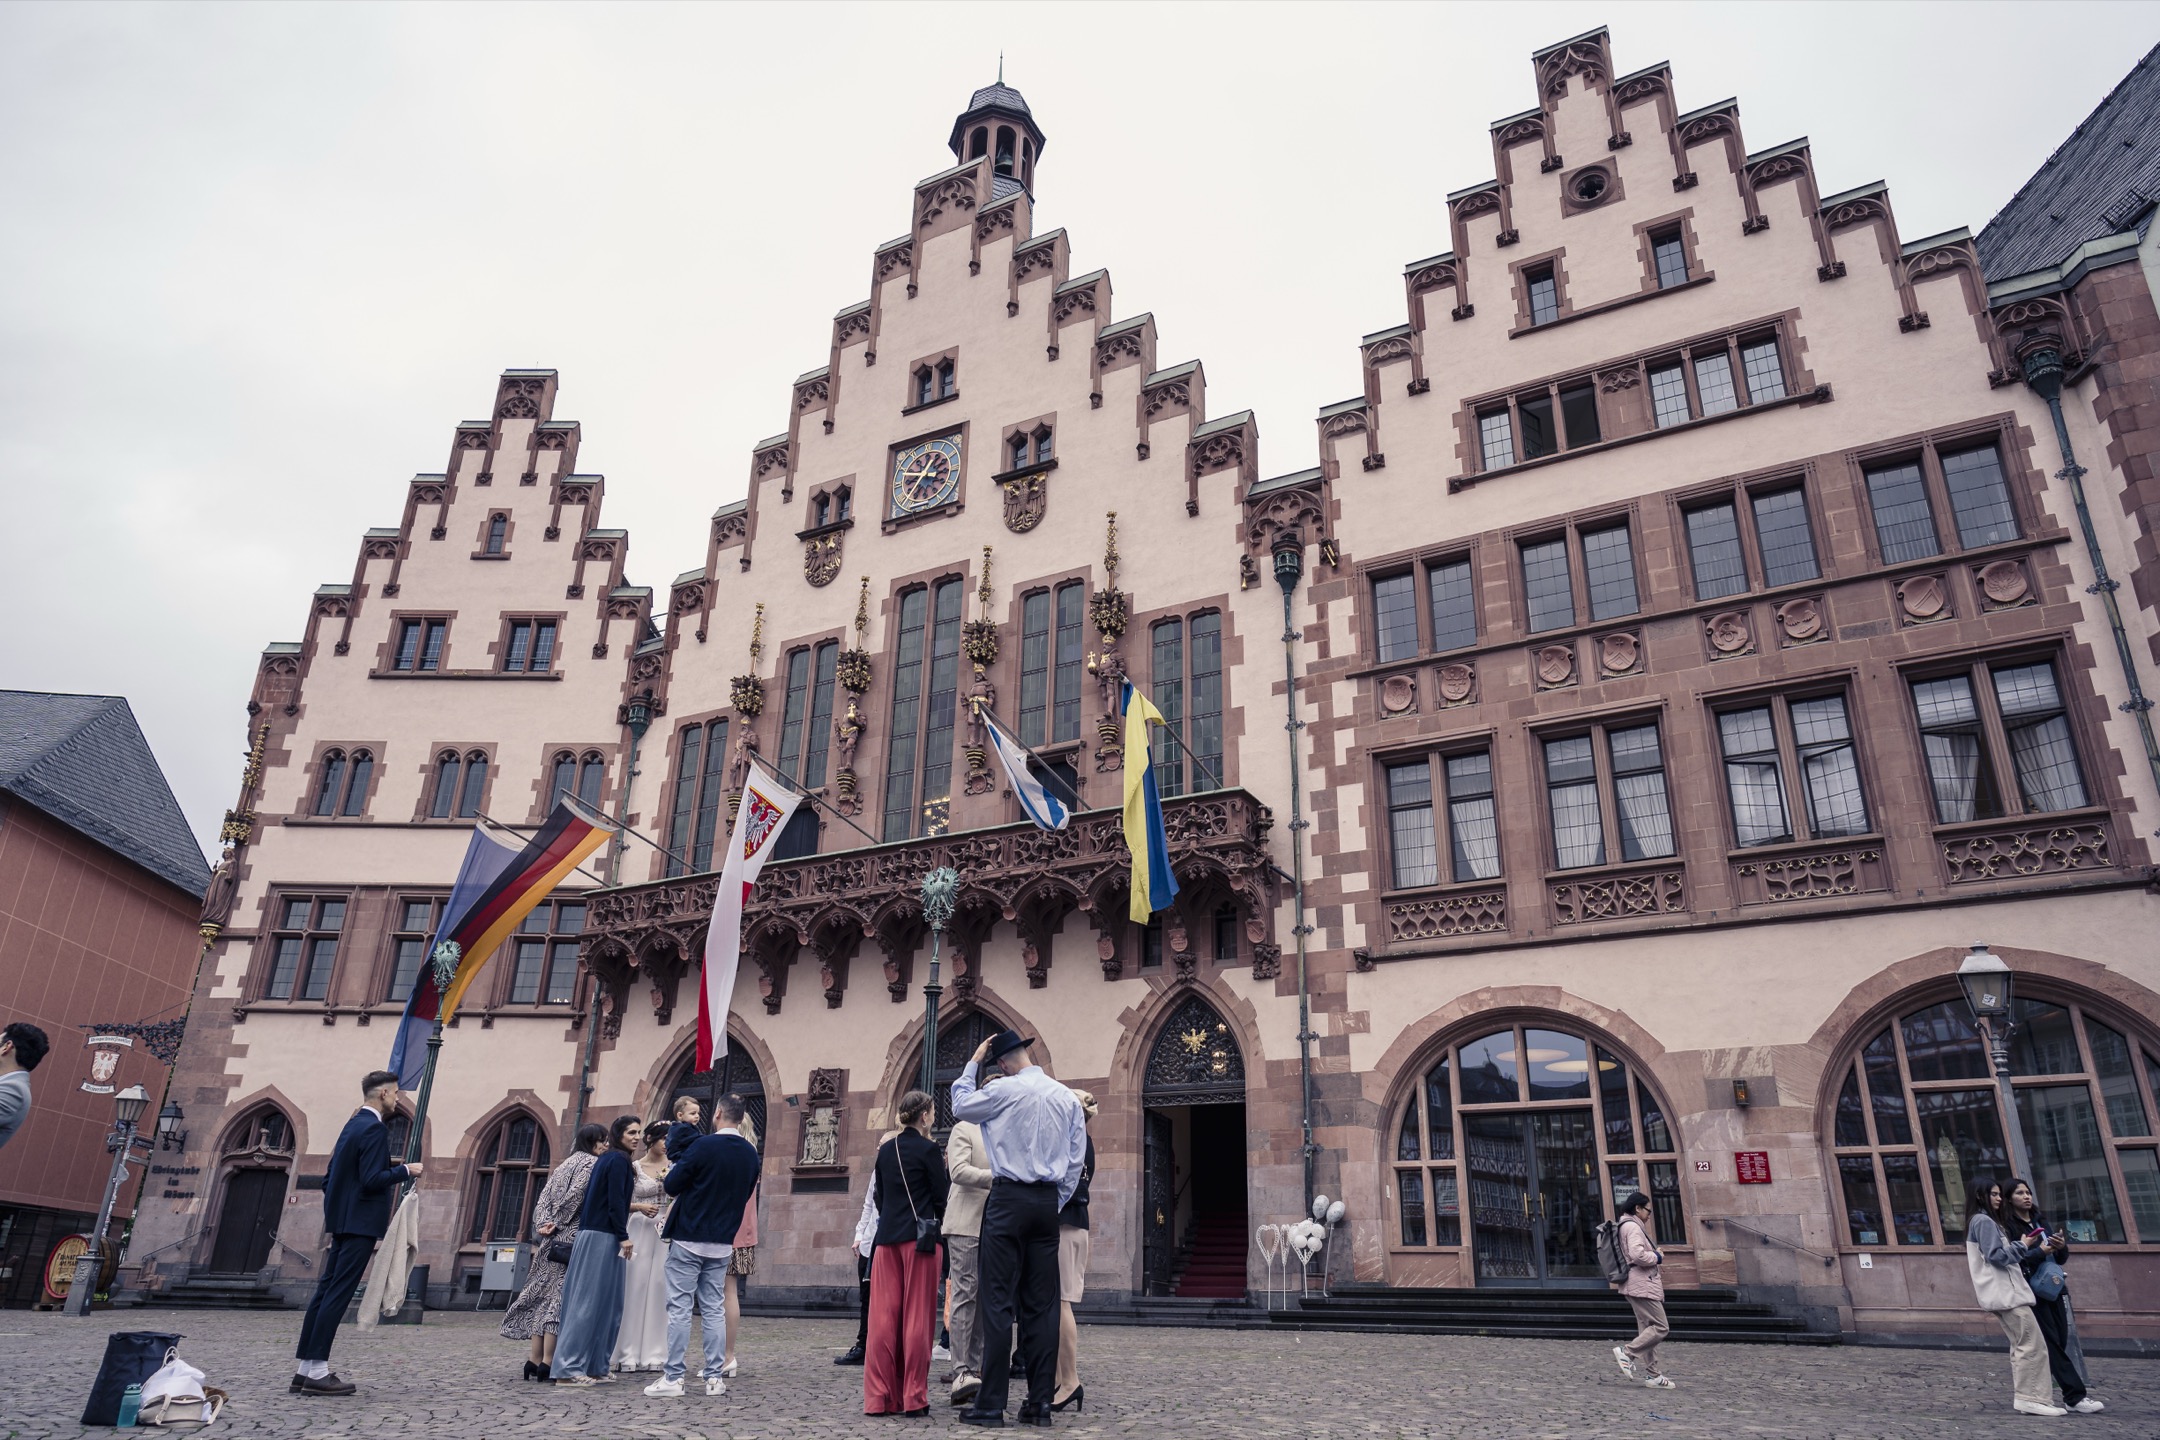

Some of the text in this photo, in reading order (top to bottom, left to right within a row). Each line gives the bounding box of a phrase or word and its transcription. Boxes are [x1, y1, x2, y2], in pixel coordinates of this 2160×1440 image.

[1697, 1162, 1709, 1171] 23
[168, 1177, 179, 1186] im
[164, 1190, 195, 1199] Römer
